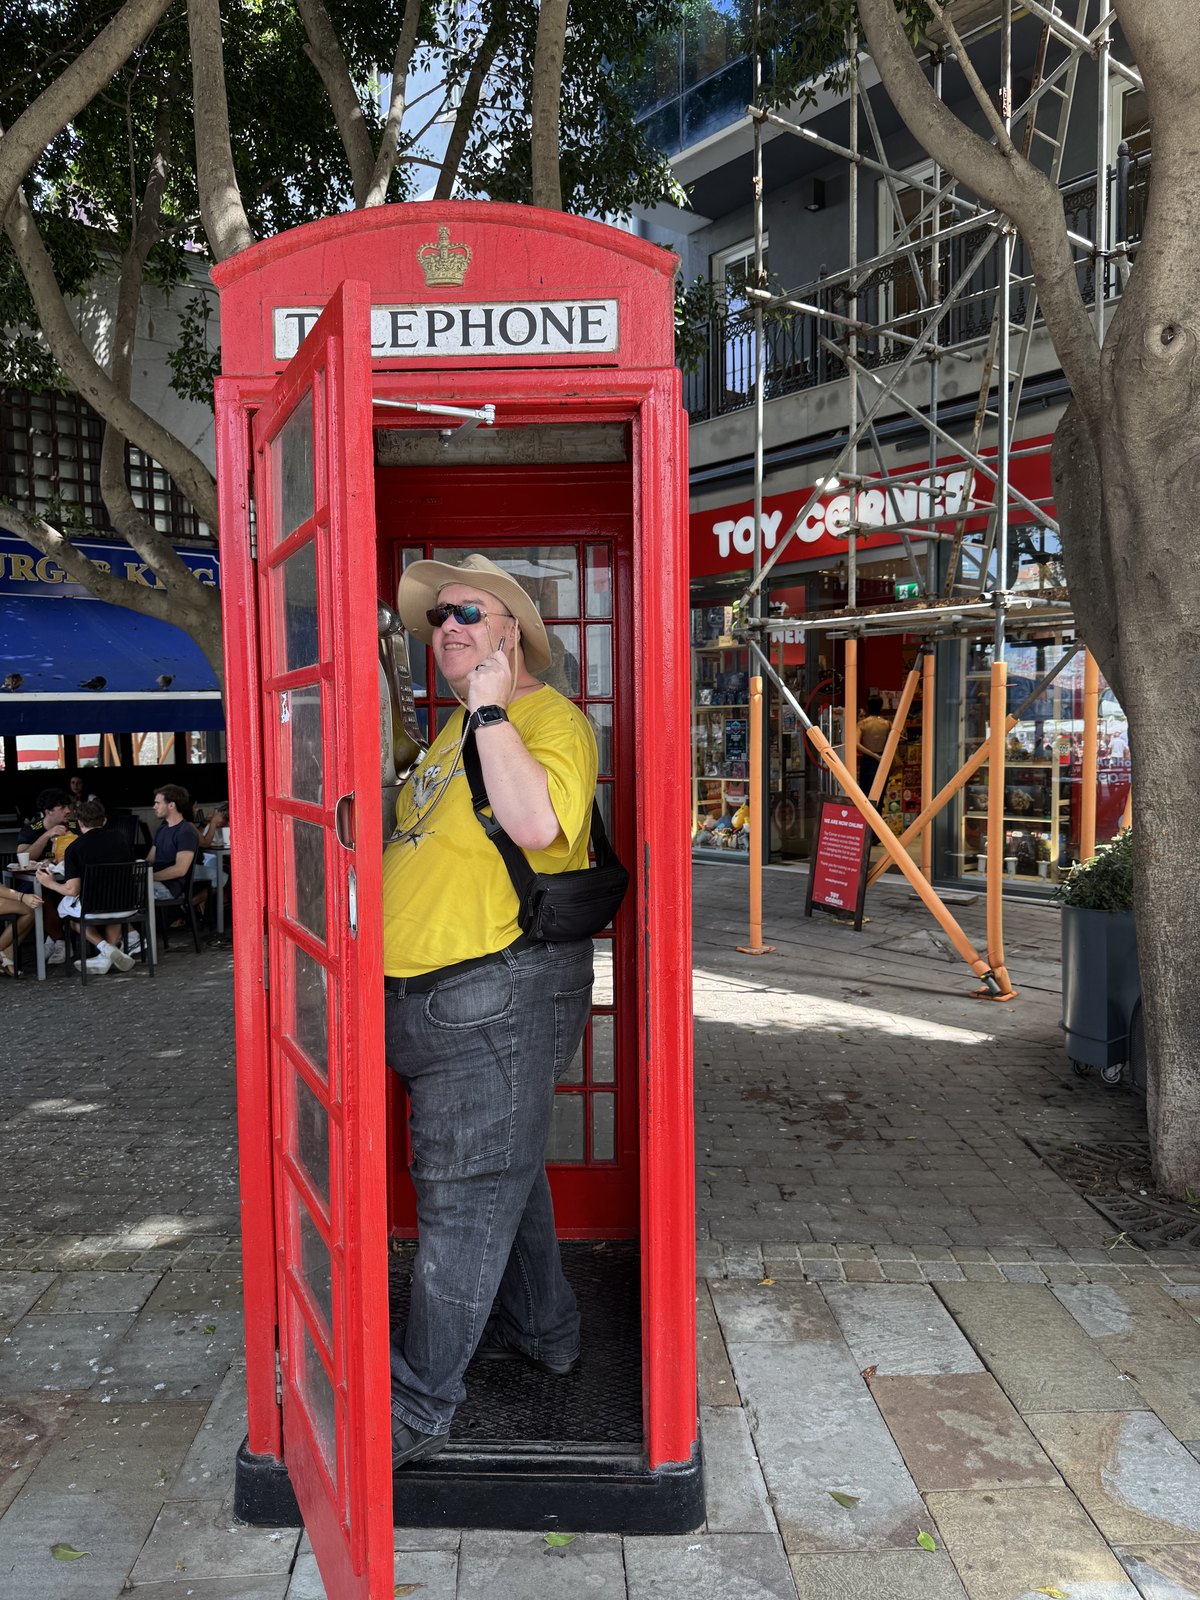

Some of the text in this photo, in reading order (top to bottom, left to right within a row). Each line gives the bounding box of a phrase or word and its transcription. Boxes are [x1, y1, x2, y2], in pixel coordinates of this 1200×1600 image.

[285, 305, 608, 350] TEPHONE
[712, 471, 977, 558] TOY CORNER
[124, 562, 216, 590] KG
